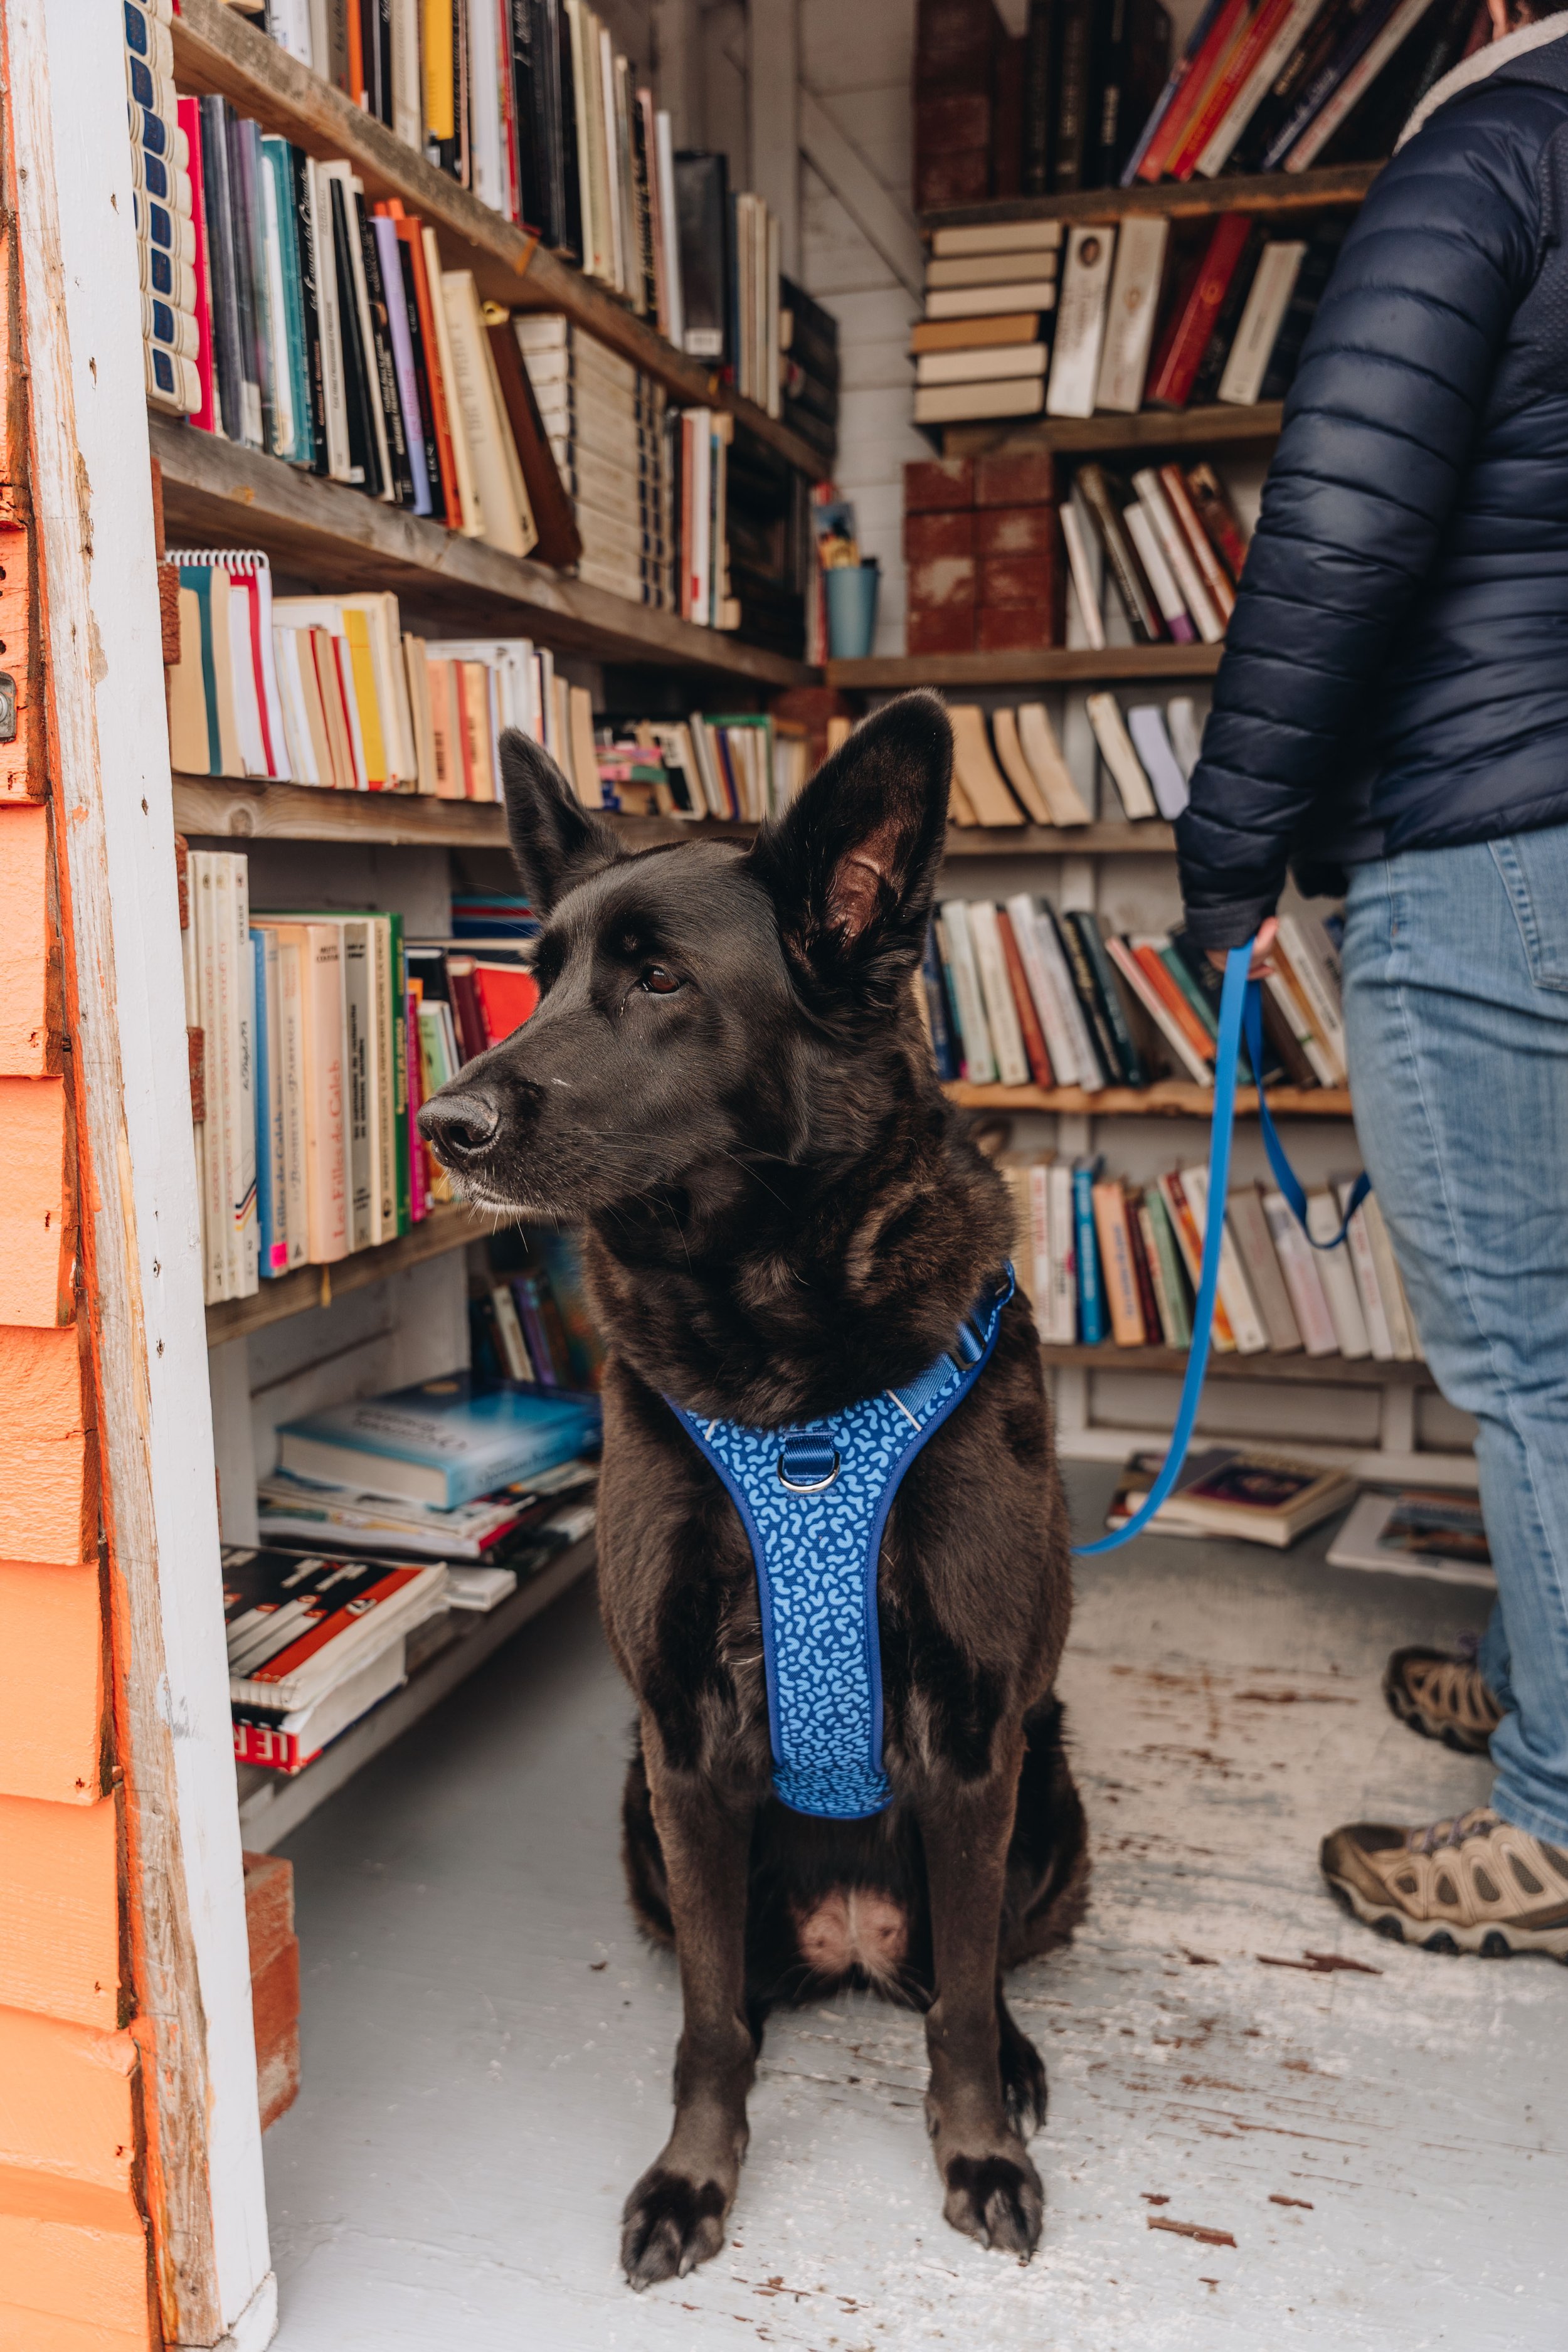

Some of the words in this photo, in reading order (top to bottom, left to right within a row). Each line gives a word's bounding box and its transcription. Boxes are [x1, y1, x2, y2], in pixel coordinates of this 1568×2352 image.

[327, 1059, 342, 1118] Caleb
[330, 1123, 342, 1143] de
[331, 1149, 344, 1200] Filles
[332, 1204, 345, 1239] Les
